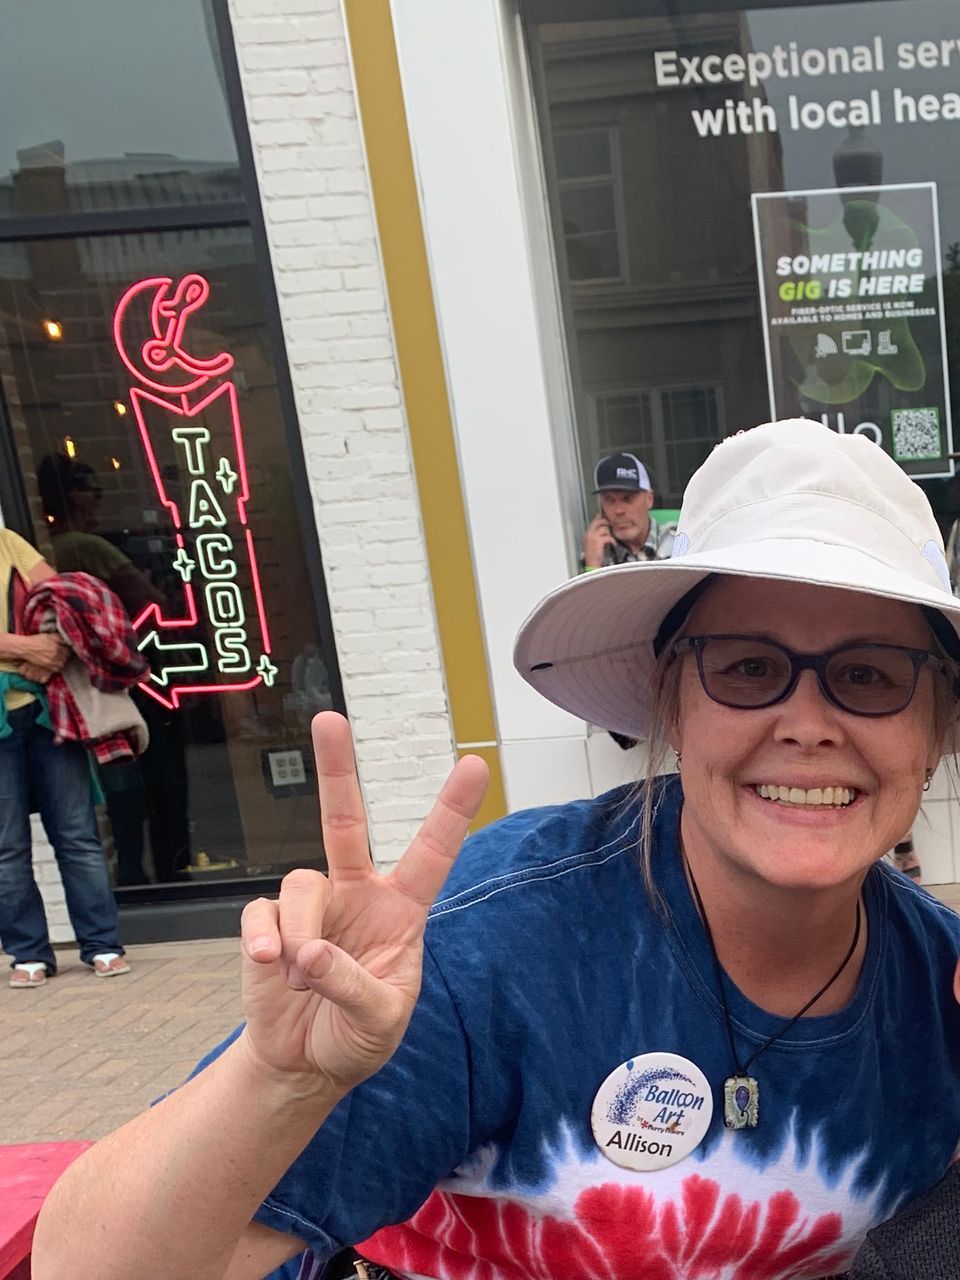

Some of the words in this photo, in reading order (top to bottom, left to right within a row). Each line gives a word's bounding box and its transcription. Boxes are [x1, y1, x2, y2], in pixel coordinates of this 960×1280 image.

[654, 37, 884, 87] Exceptional
[691, 99, 777, 137] with
[789, 90, 881, 130] local
[776, 249, 923, 276] SOMETHING
[779, 280, 822, 301] GIG
[828, 279, 851, 298] IS
[858, 274, 925, 296] HERE
[771, 313, 818, 325] AVAILABLE
[820, 313, 832, 323] TO
[865, 311, 883, 319] AND
[846, 303, 881, 312] SERVICE
[172, 426, 251, 674] TACOS
[644, 1085, 705, 1110] Balloon
[653, 1107, 685, 1126] Art
[606, 1130, 673, 1157] Allison
